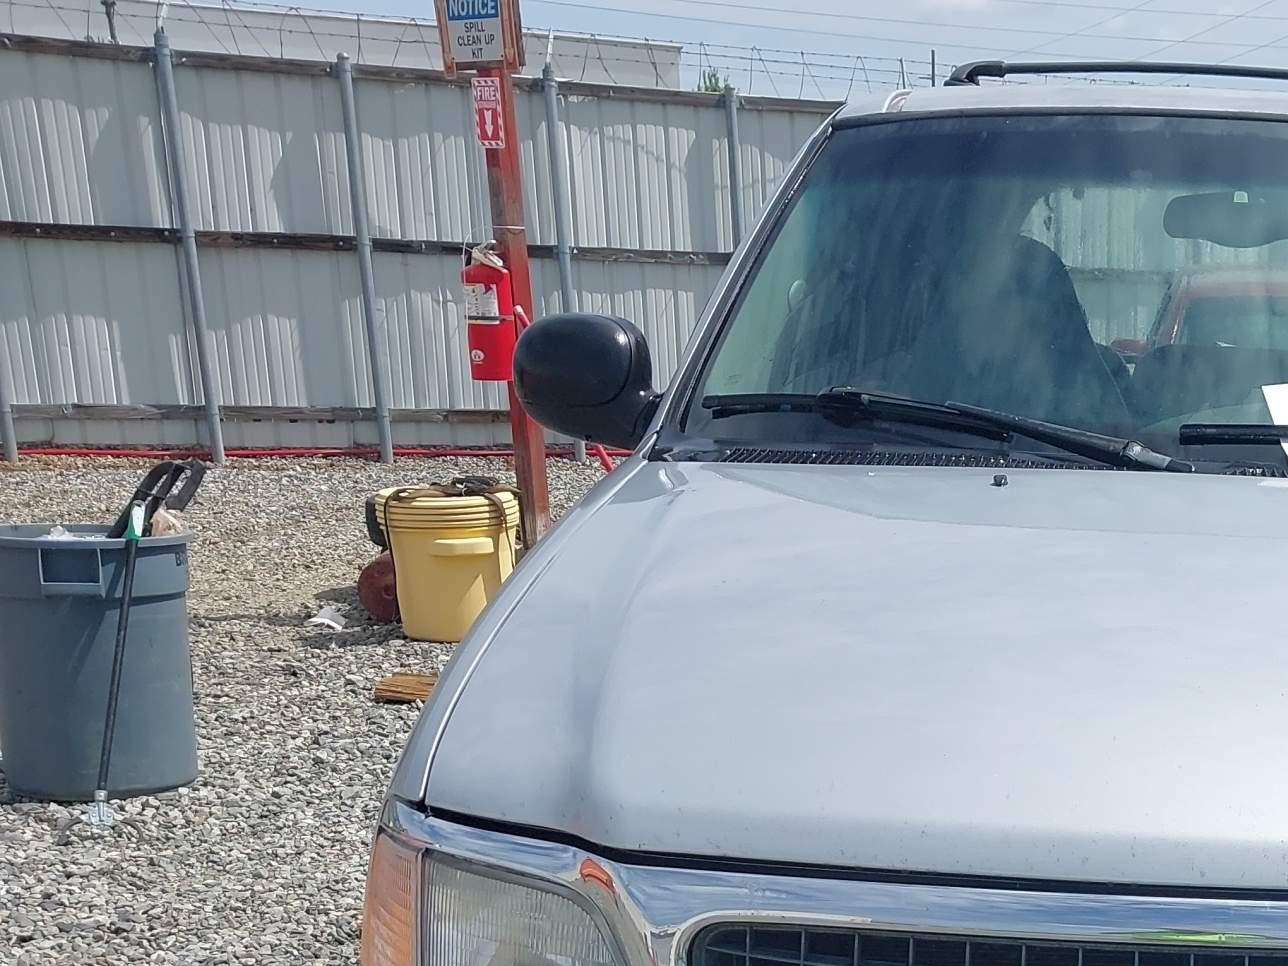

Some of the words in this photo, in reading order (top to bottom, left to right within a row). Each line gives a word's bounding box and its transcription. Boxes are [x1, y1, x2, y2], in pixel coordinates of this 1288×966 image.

[449, 0, 496, 17] NOTICE
[464, 21, 486, 33] SPILL
[457, 35, 482, 47] CLEAN
[484, 33, 495, 45] UP
[471, 48, 483, 59] KIT
[477, 86, 496, 100] FIRE
